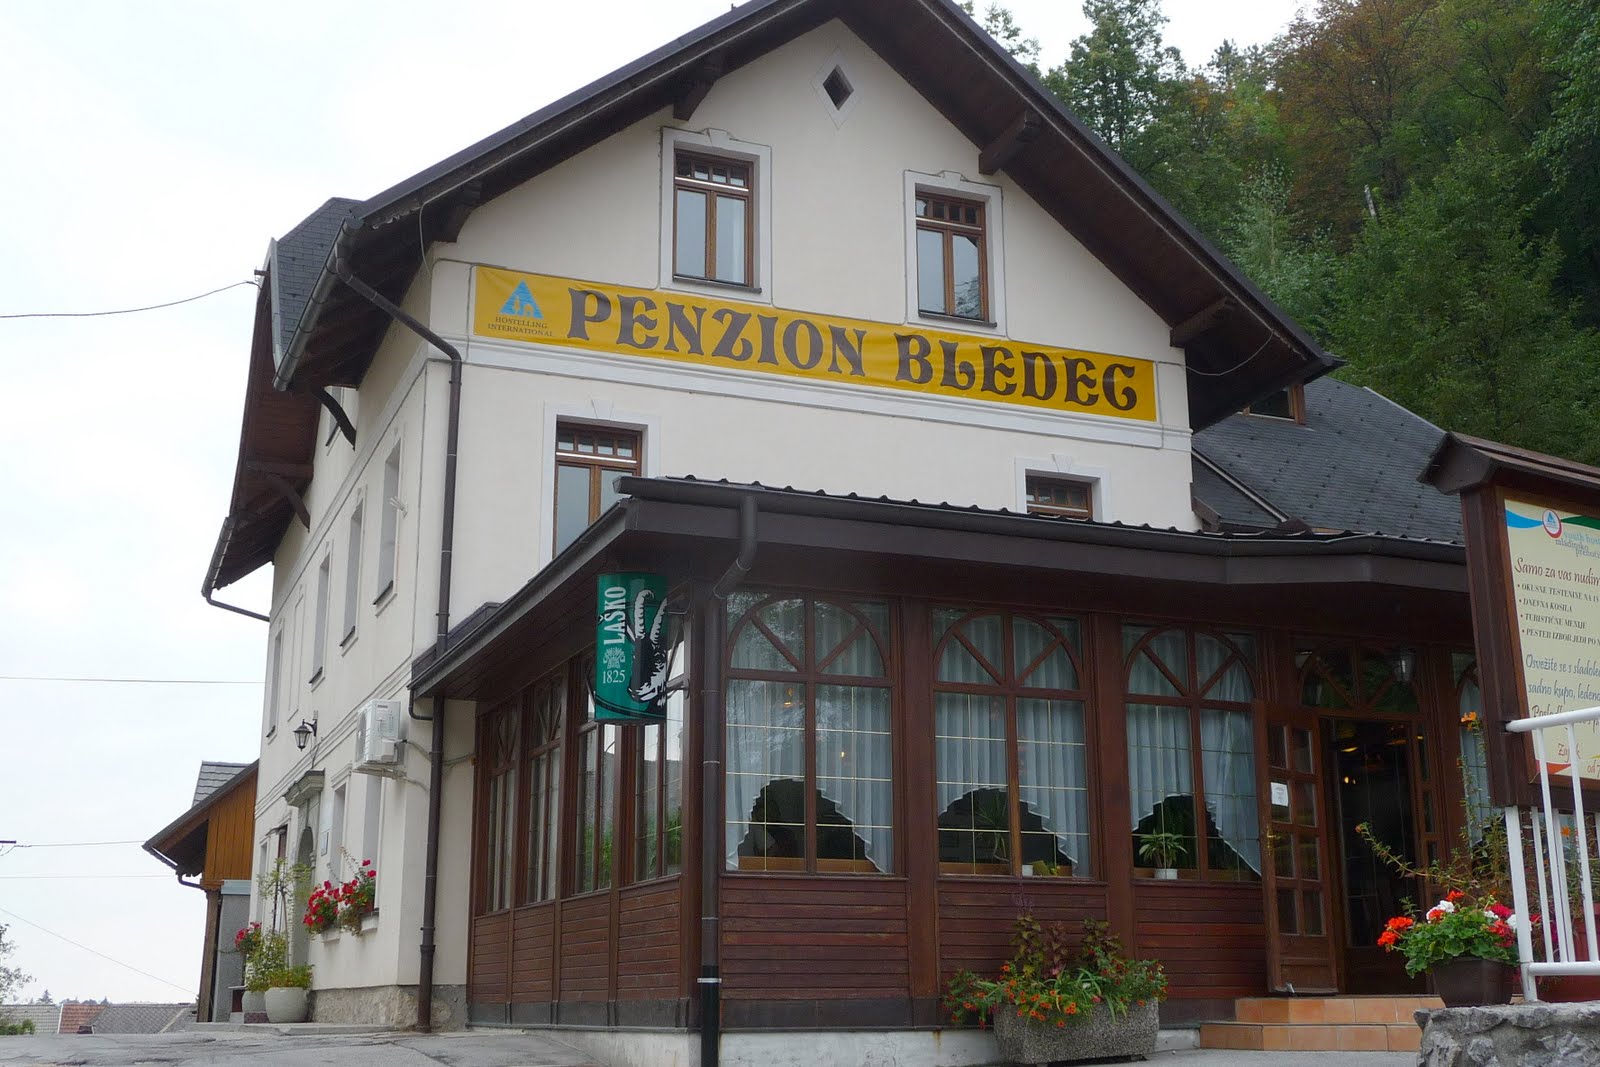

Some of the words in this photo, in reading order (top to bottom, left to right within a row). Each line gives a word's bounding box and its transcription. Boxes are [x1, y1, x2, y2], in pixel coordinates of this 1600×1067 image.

[487, 323, 553, 337] INTERNATIONAL
[495, 316, 548, 329] HOSTELLING
[568, 287, 867, 377] PENZION
[894, 332, 1138, 410] BLEDEC
[1514, 557, 1543, 577] Samo
[1545, 567, 1556, 578] za
[1558, 570, 1572, 582] vas
[1522, 583, 1547, 594] OKUSNE
[1549, 587, 1583, 600] TESTENINE
[1523, 598, 1549, 610] DNEVNA
[1550, 602, 1573, 613] KOSILA
[599, 586, 627, 645] LAŠKO
[1526, 628, 1552, 639] PESTER
[1526, 654, 1558, 672] Osvežite
[1559, 663, 1567, 672] se
[602, 670, 626, 684] 1825
[1528, 678, 1553, 696] sadno
